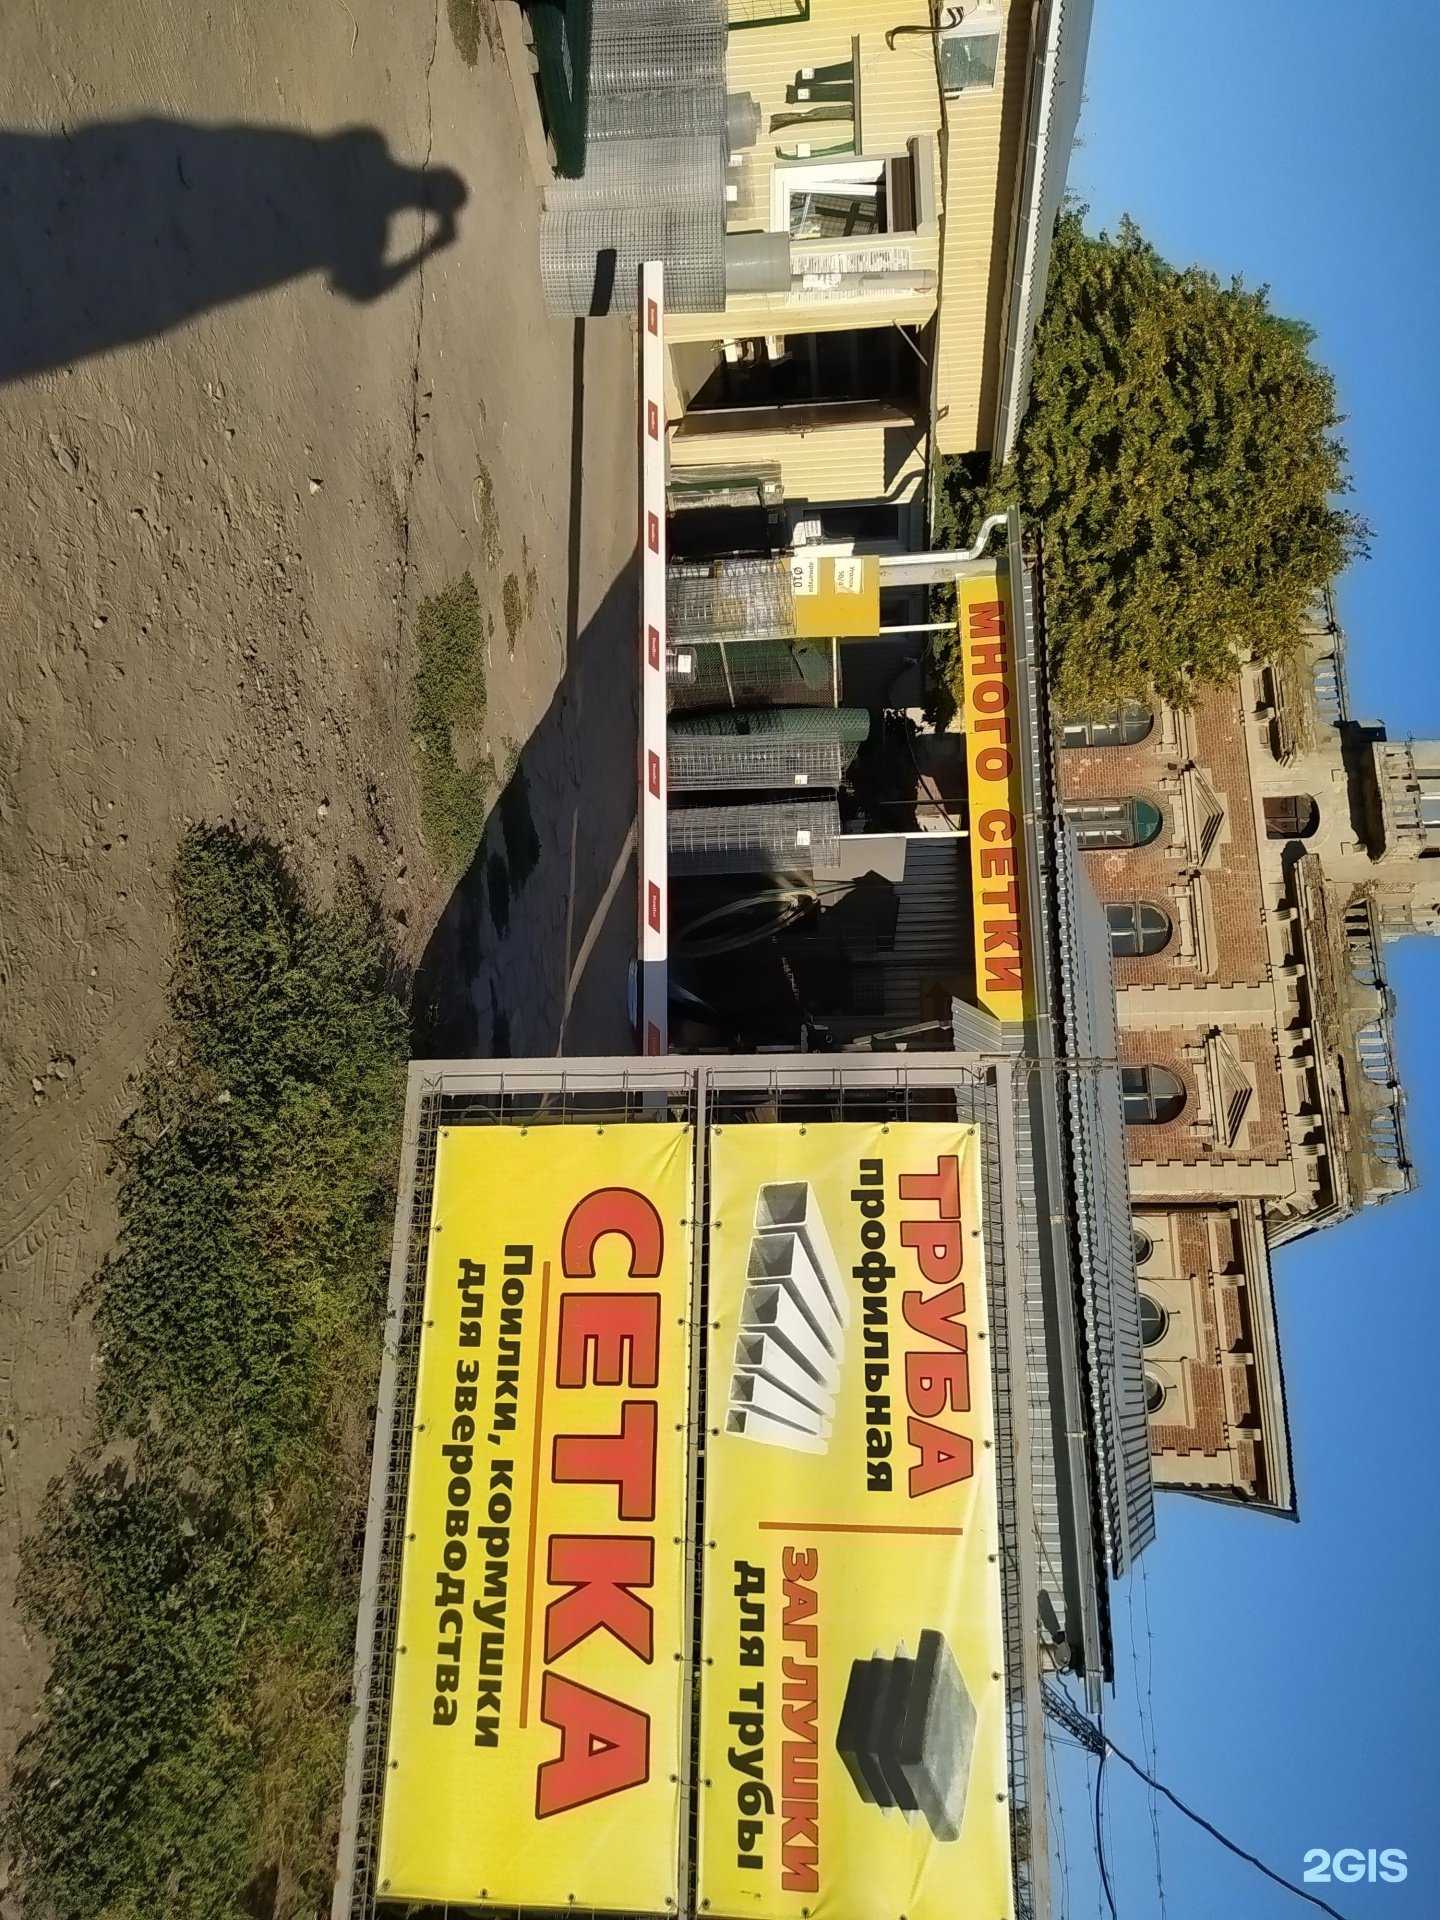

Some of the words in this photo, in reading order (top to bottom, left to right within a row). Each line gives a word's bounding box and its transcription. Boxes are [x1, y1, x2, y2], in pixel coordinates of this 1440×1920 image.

[968, 600, 1013, 782] МНОГО
[978, 808, 1024, 992] СЕТКИ
[457, 1257, 487, 1348] для
[486, 1243, 534, 1447] Поилки,
[852, 1158, 896, 1493] профильная
[897, 1155, 974, 1499] ТРУБА
[433, 1359, 476, 1727] звероводства
[473, 1458, 514, 1749] кормушки
[534, 1187, 665, 1820] СЕТКА
[734, 1560, 772, 1666] для
[728, 1681, 773, 1870] трубы
[780, 1545, 819, 1893] ЗАГЛУШКИ
